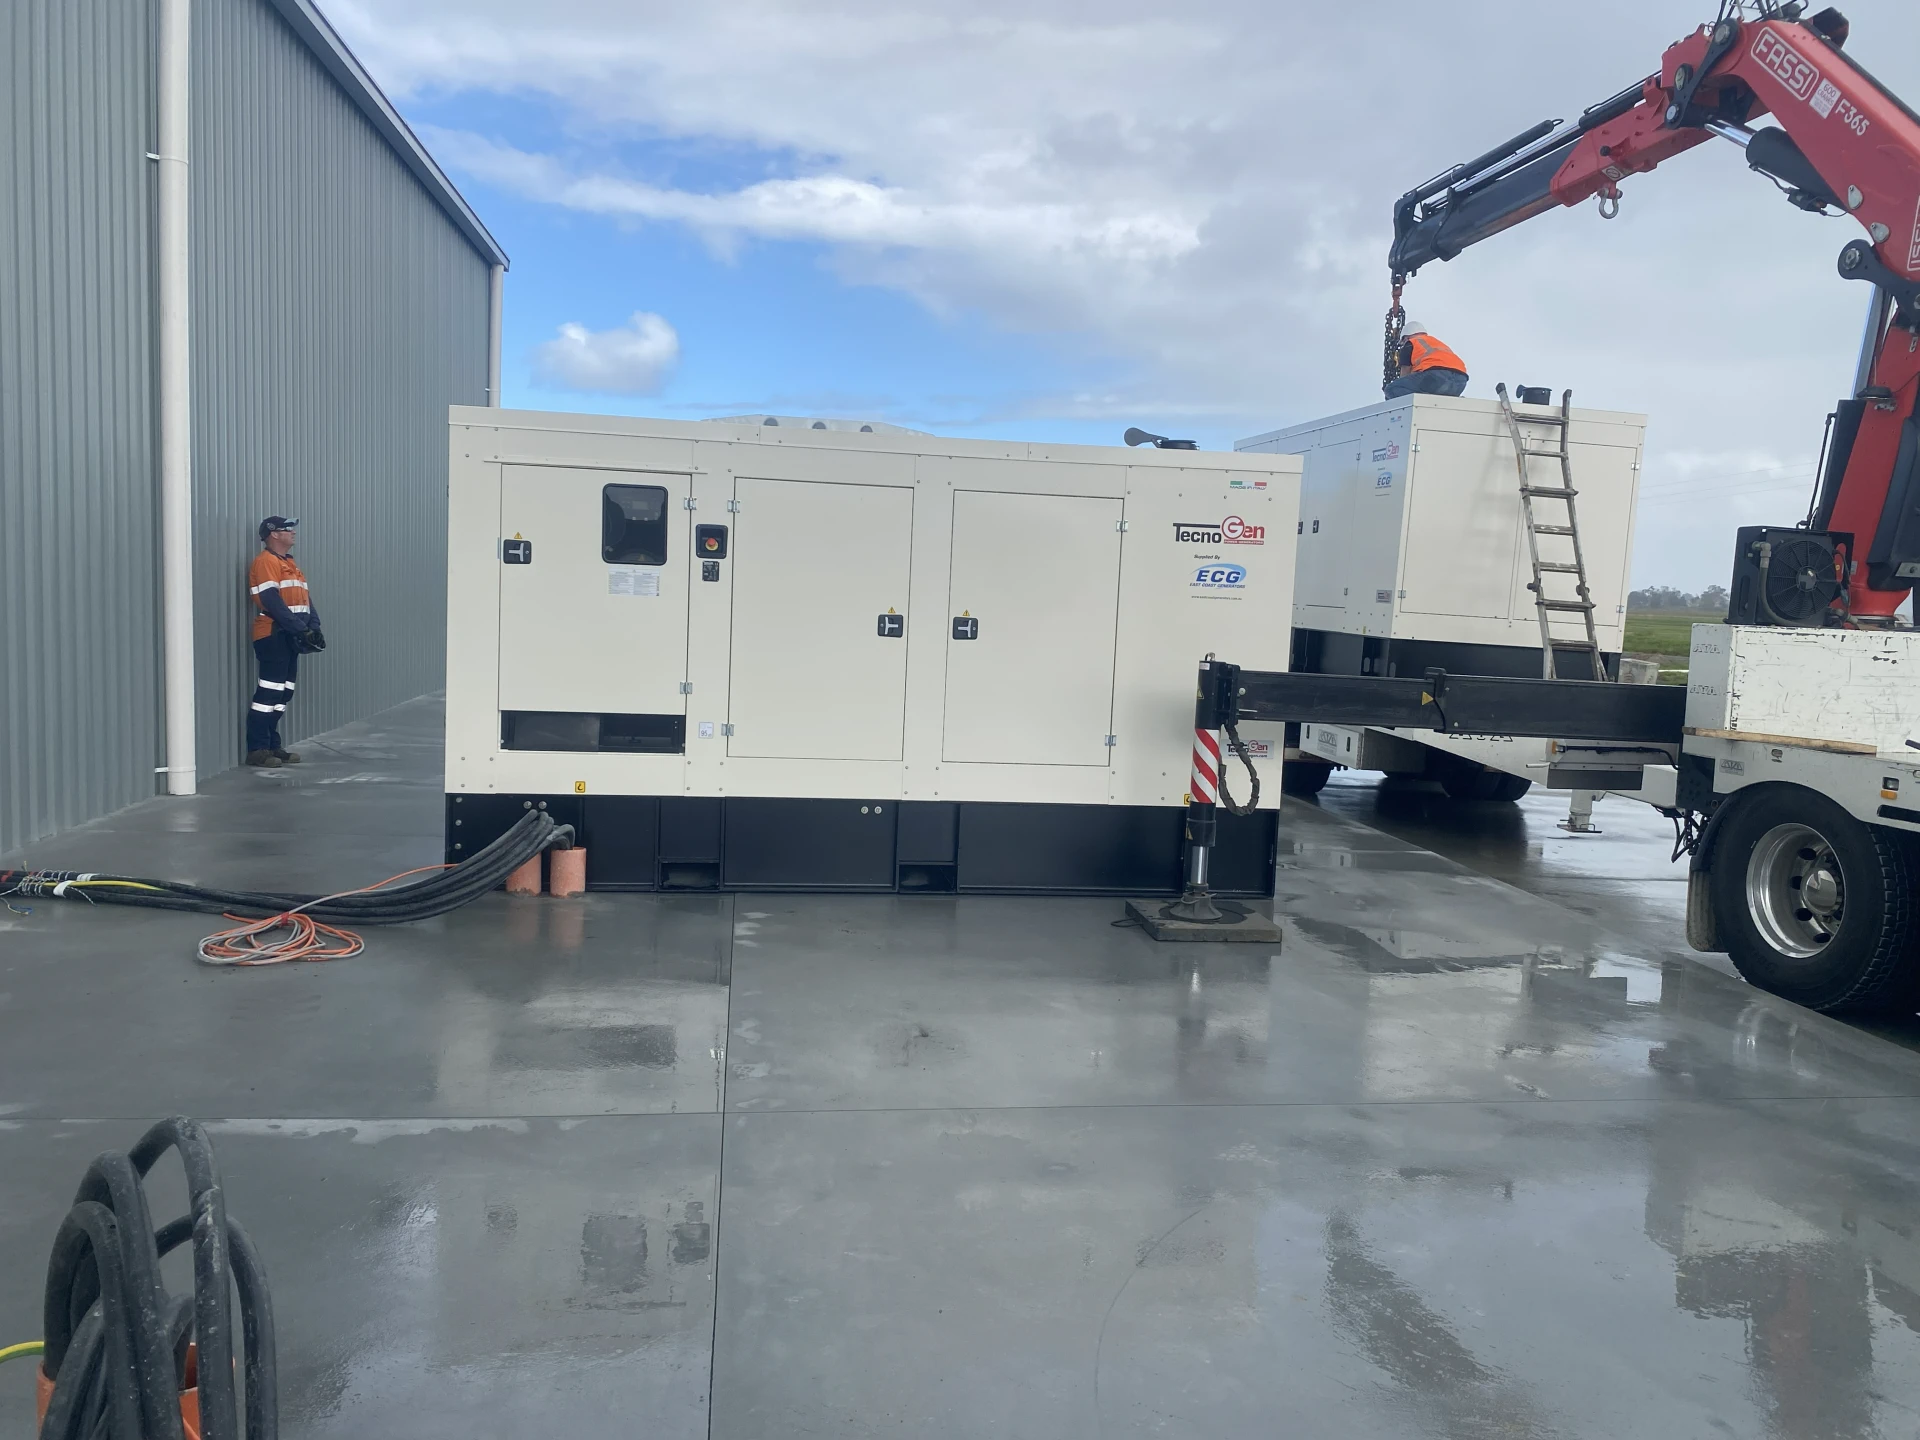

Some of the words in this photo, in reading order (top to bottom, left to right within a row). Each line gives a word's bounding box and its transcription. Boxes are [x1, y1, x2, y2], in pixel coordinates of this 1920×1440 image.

[1755, 33, 1814, 94] FASSI
[1835, 98, 1870, 136] F365
[1196, 570, 1241, 584] ECG
